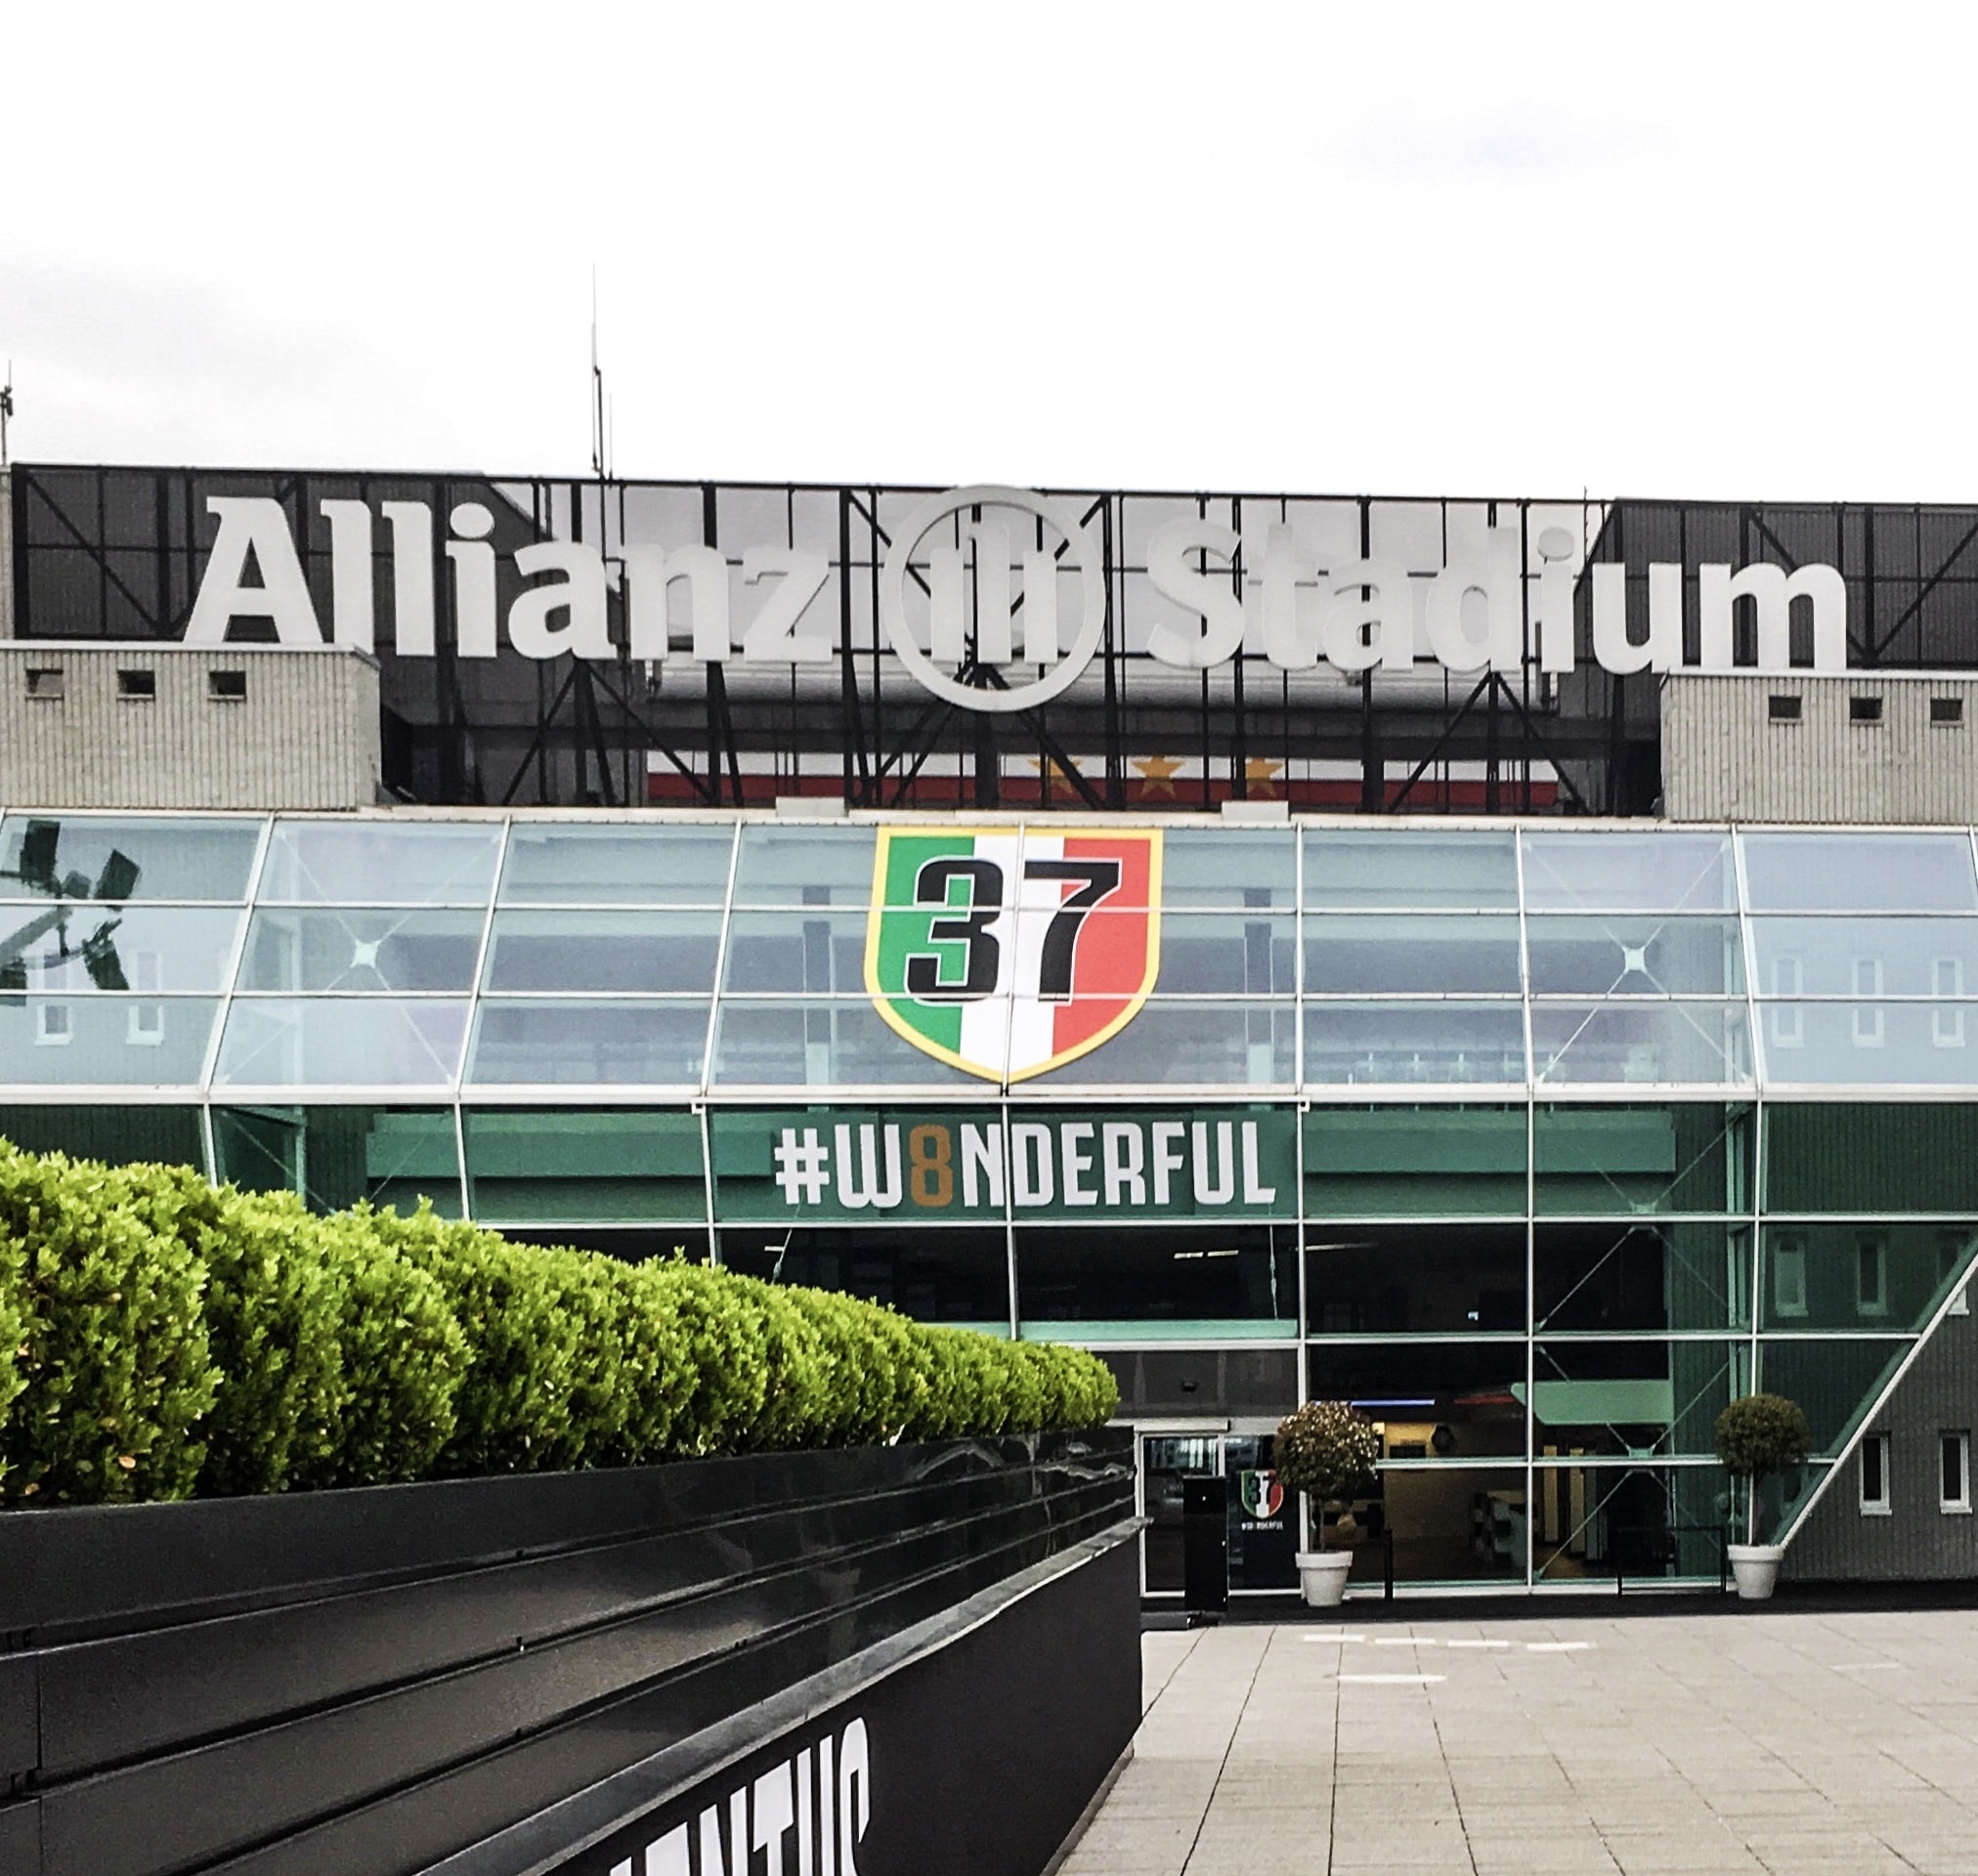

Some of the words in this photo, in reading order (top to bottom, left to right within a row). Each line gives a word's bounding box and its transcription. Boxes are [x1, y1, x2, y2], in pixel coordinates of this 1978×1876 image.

[184, 495, 834, 663] Allianz
[1145, 519, 1848, 675] Stadium
[905, 855, 1123, 1006] 37
[773, 1121, 1277, 1210] #W8NDERFUL
